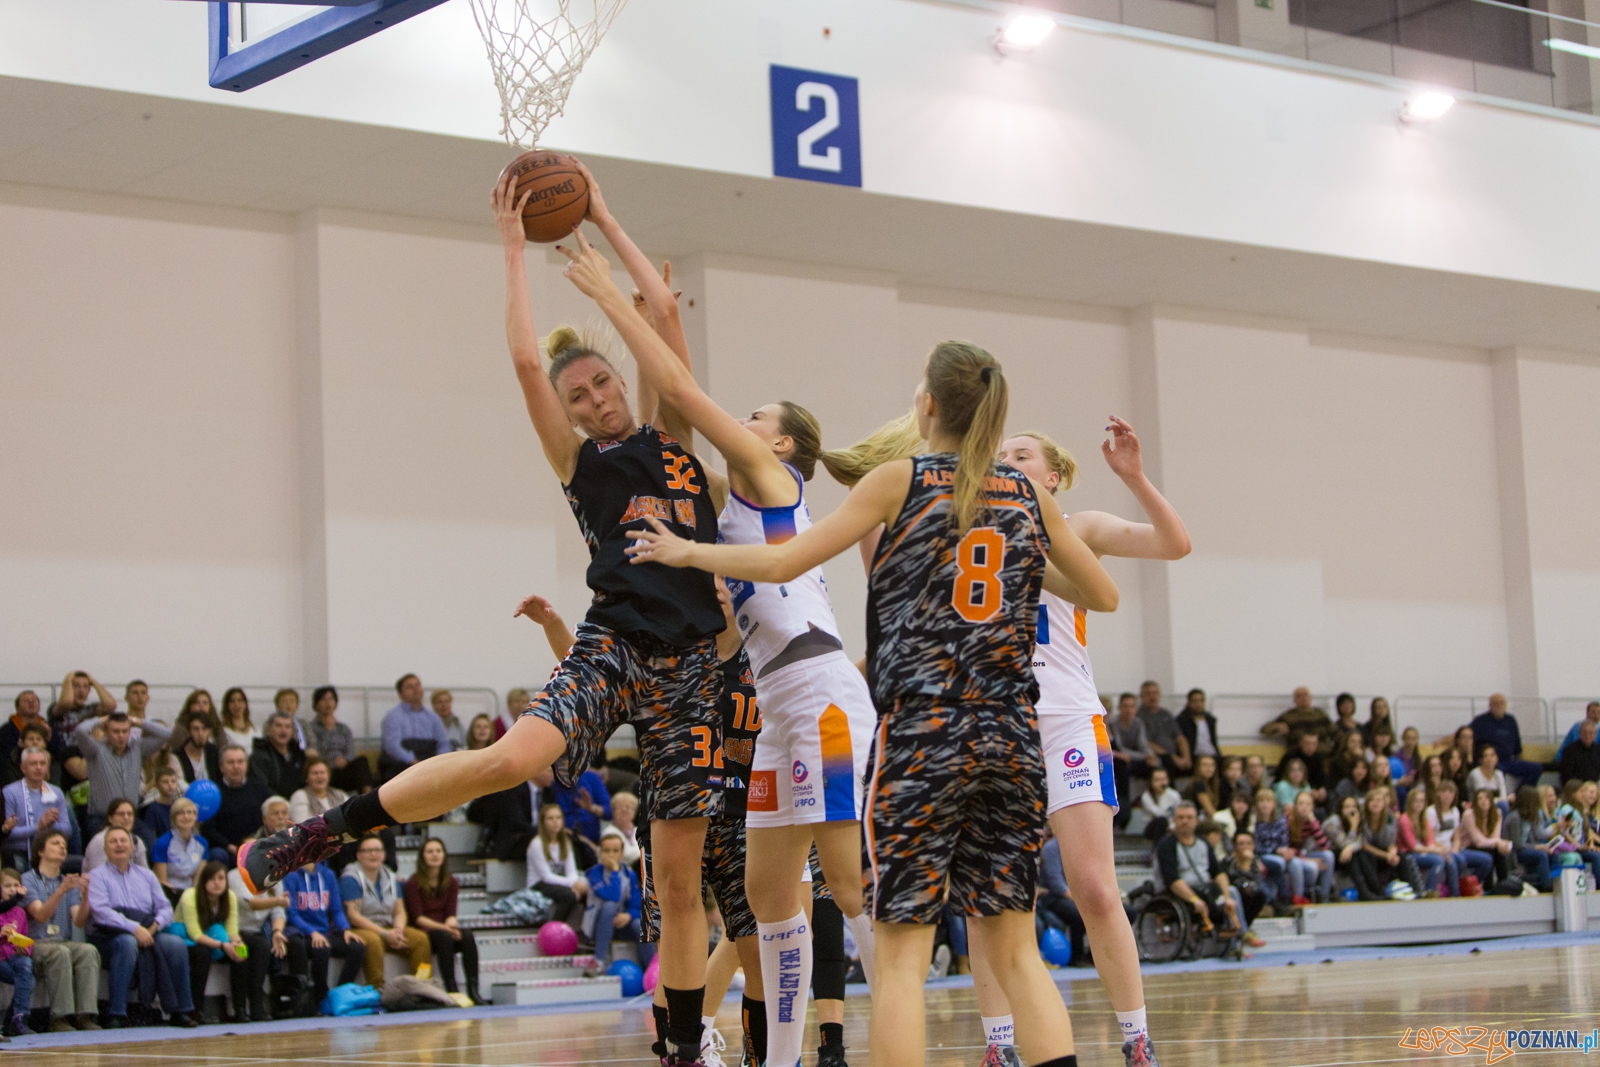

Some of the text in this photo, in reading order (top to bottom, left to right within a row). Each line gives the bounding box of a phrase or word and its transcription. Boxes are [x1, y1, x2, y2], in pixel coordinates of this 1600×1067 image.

[795, 81, 841, 173] 2
[515, 179, 575, 207] SPALDIN
[662, 450, 701, 495] 32
[674, 499, 697, 531] SM
[952, 526, 1006, 623] 8
[731, 692, 763, 732] 10
[1063, 767, 1090, 778] POZNAŃ
[792, 783, 813, 792] OZNAŃ
[297, 891, 330, 911] USA
[779, 947, 800, 970] ENEA
[779, 973, 800, 989] AZS
